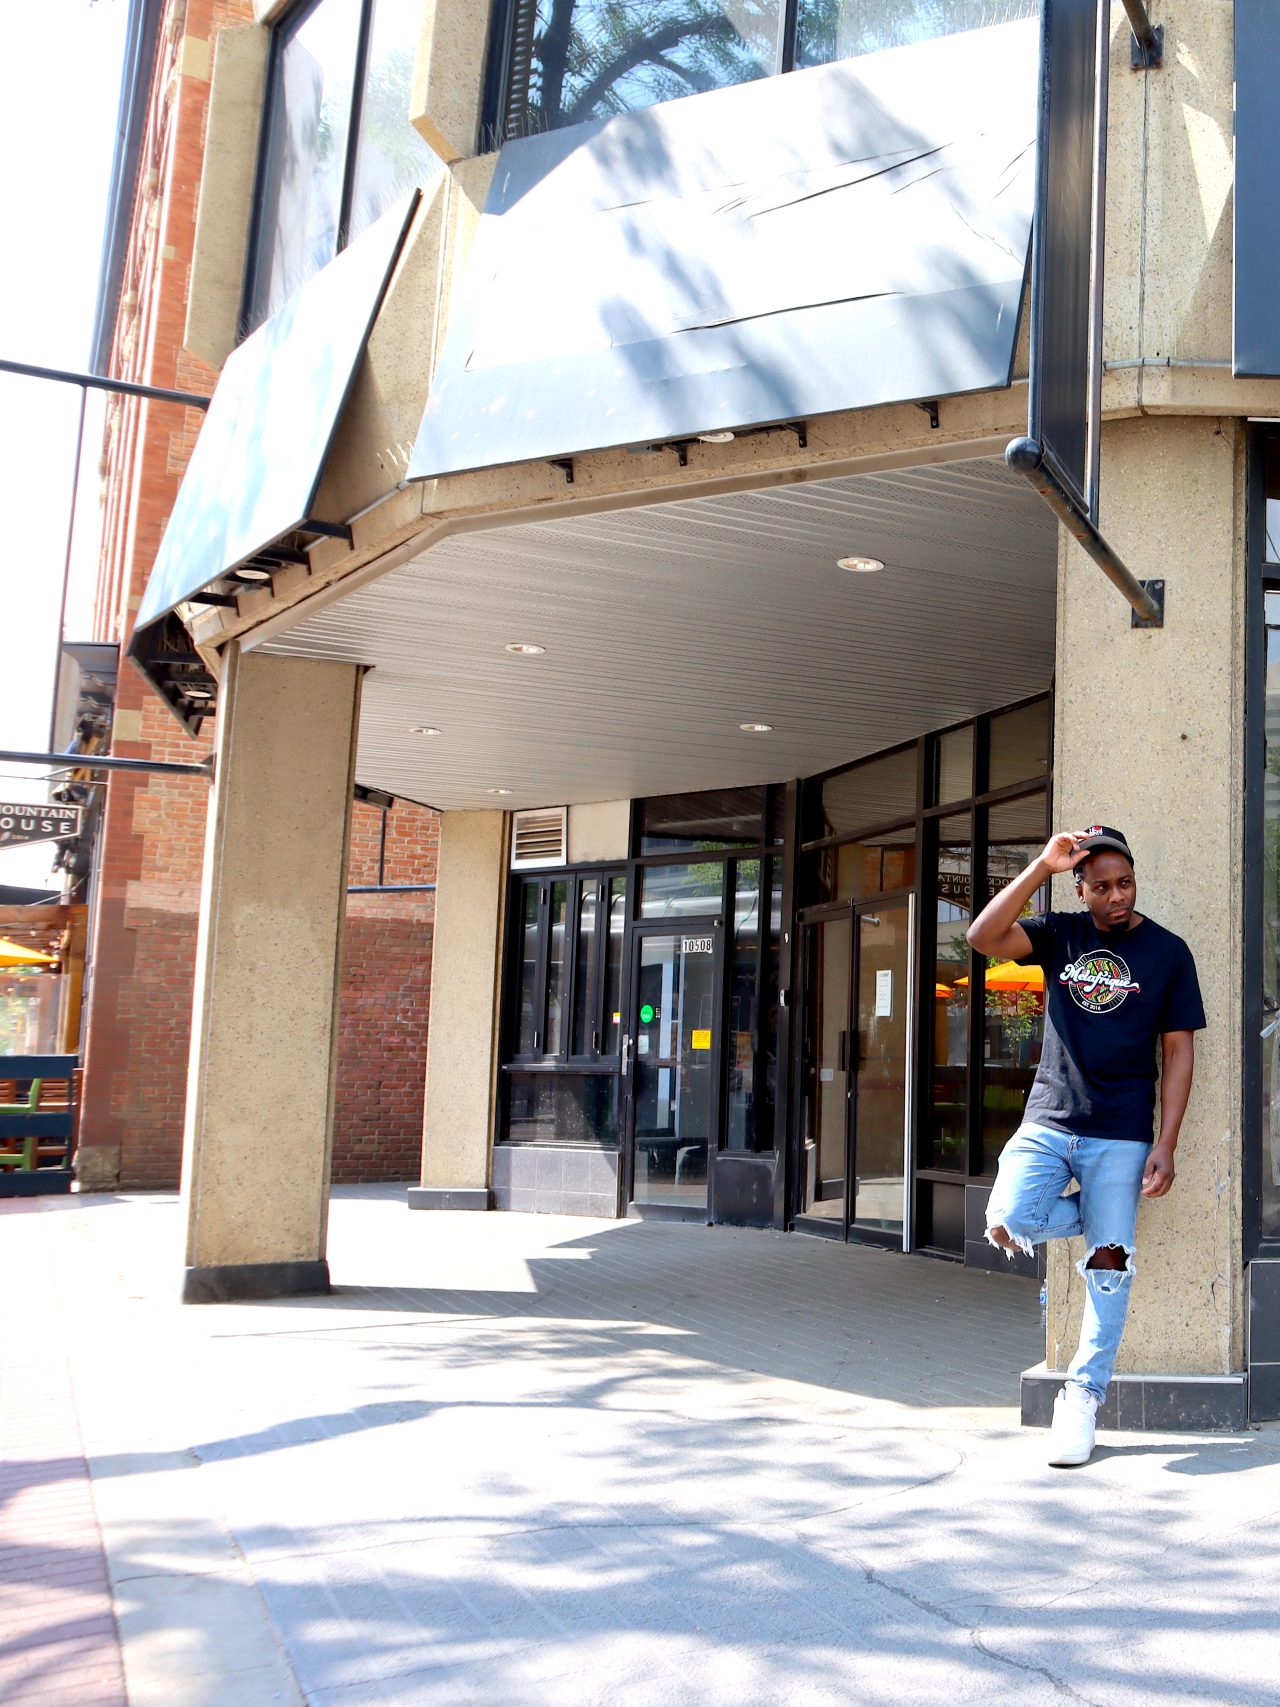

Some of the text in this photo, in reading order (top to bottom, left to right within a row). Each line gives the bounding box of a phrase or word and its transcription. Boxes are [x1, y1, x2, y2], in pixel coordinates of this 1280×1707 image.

[0, 805, 76, 819] OUNTAIN
[684, 939, 711, 951] 10508
[1060, 964, 1140, 992] Melafrique
